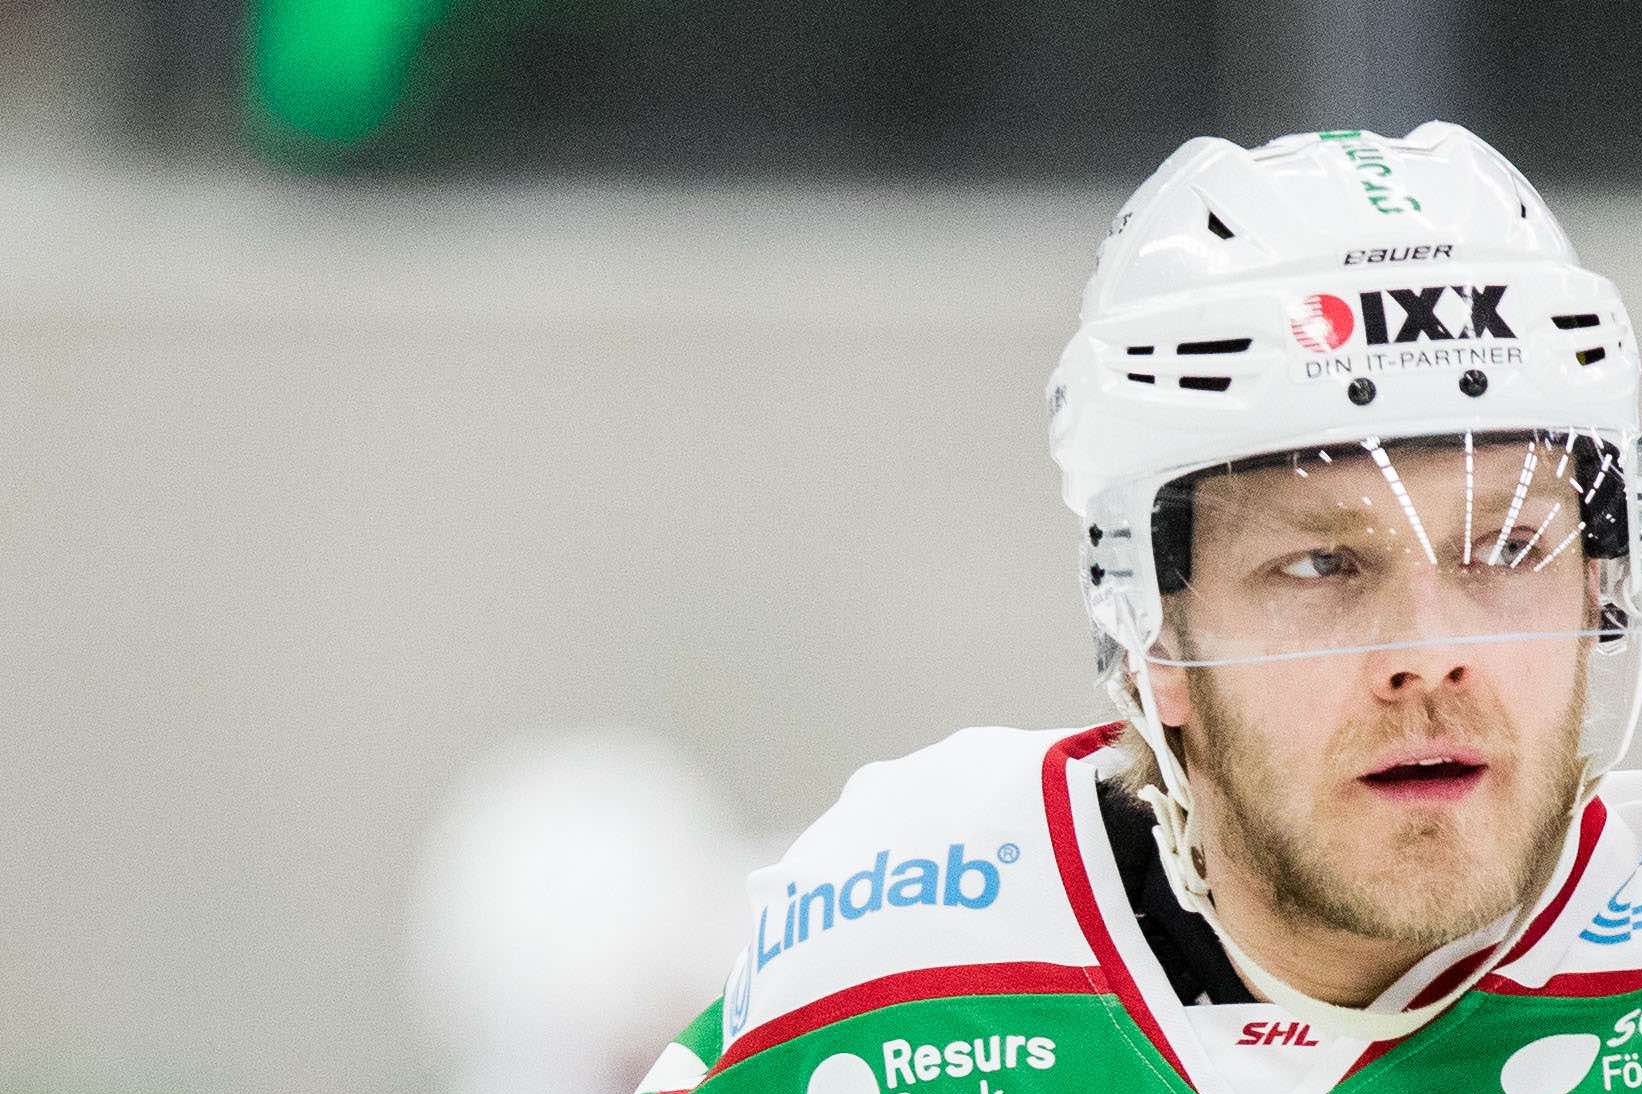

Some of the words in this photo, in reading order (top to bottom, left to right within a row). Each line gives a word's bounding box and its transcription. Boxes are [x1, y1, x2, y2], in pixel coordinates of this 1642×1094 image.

[1306, 357, 1352, 379] DIN
[1367, 347, 1523, 371] IT-PARTNER
[1235, 1021, 1320, 1047] SHL
[882, 1035, 1056, 1088] Resurs
